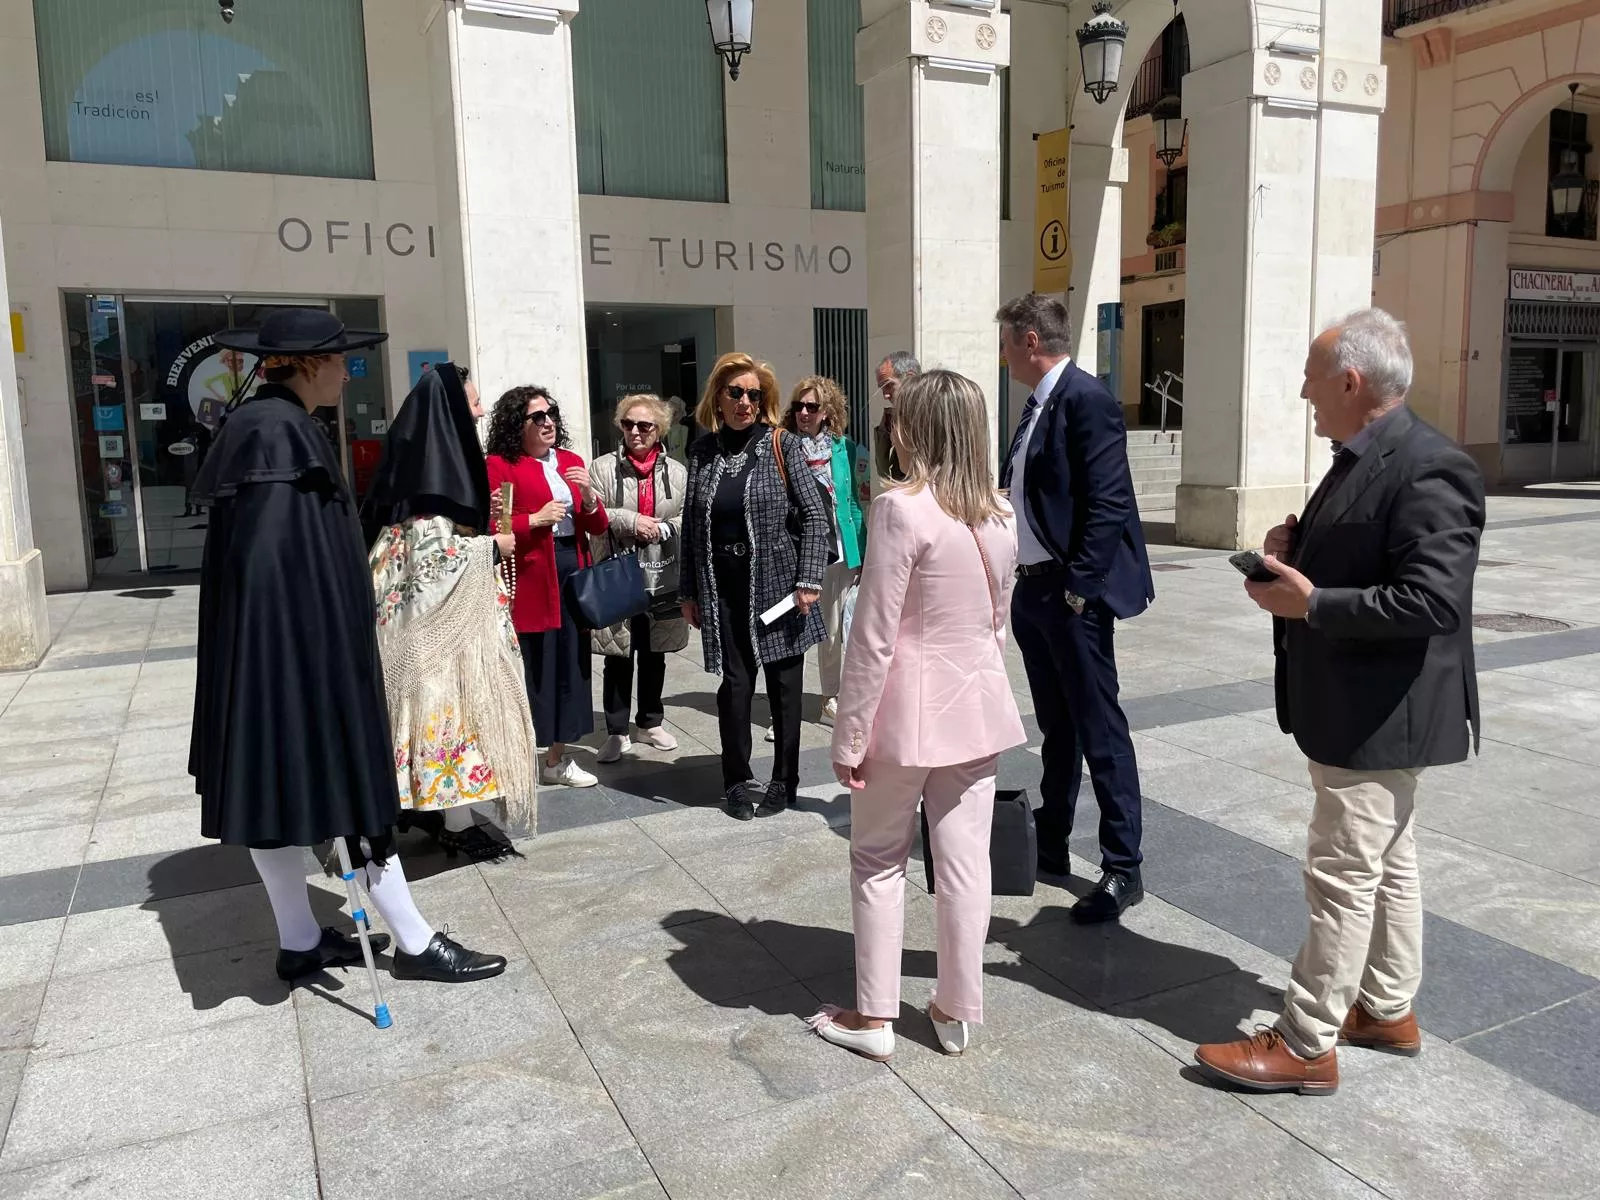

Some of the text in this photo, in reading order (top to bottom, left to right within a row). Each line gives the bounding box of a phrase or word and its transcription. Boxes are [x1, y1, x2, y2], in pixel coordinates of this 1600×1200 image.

[72, 101, 150, 120] Tradición
[1043, 156, 1067, 169] Oficina
[1057, 168, 1066, 178] de
[278, 217, 852, 274] OFICI E TURISMO
[1513, 271, 1573, 292] CHACINERIA
[166, 334, 215, 388] BIENVENI
[615, 382, 653, 391] Por la otra
